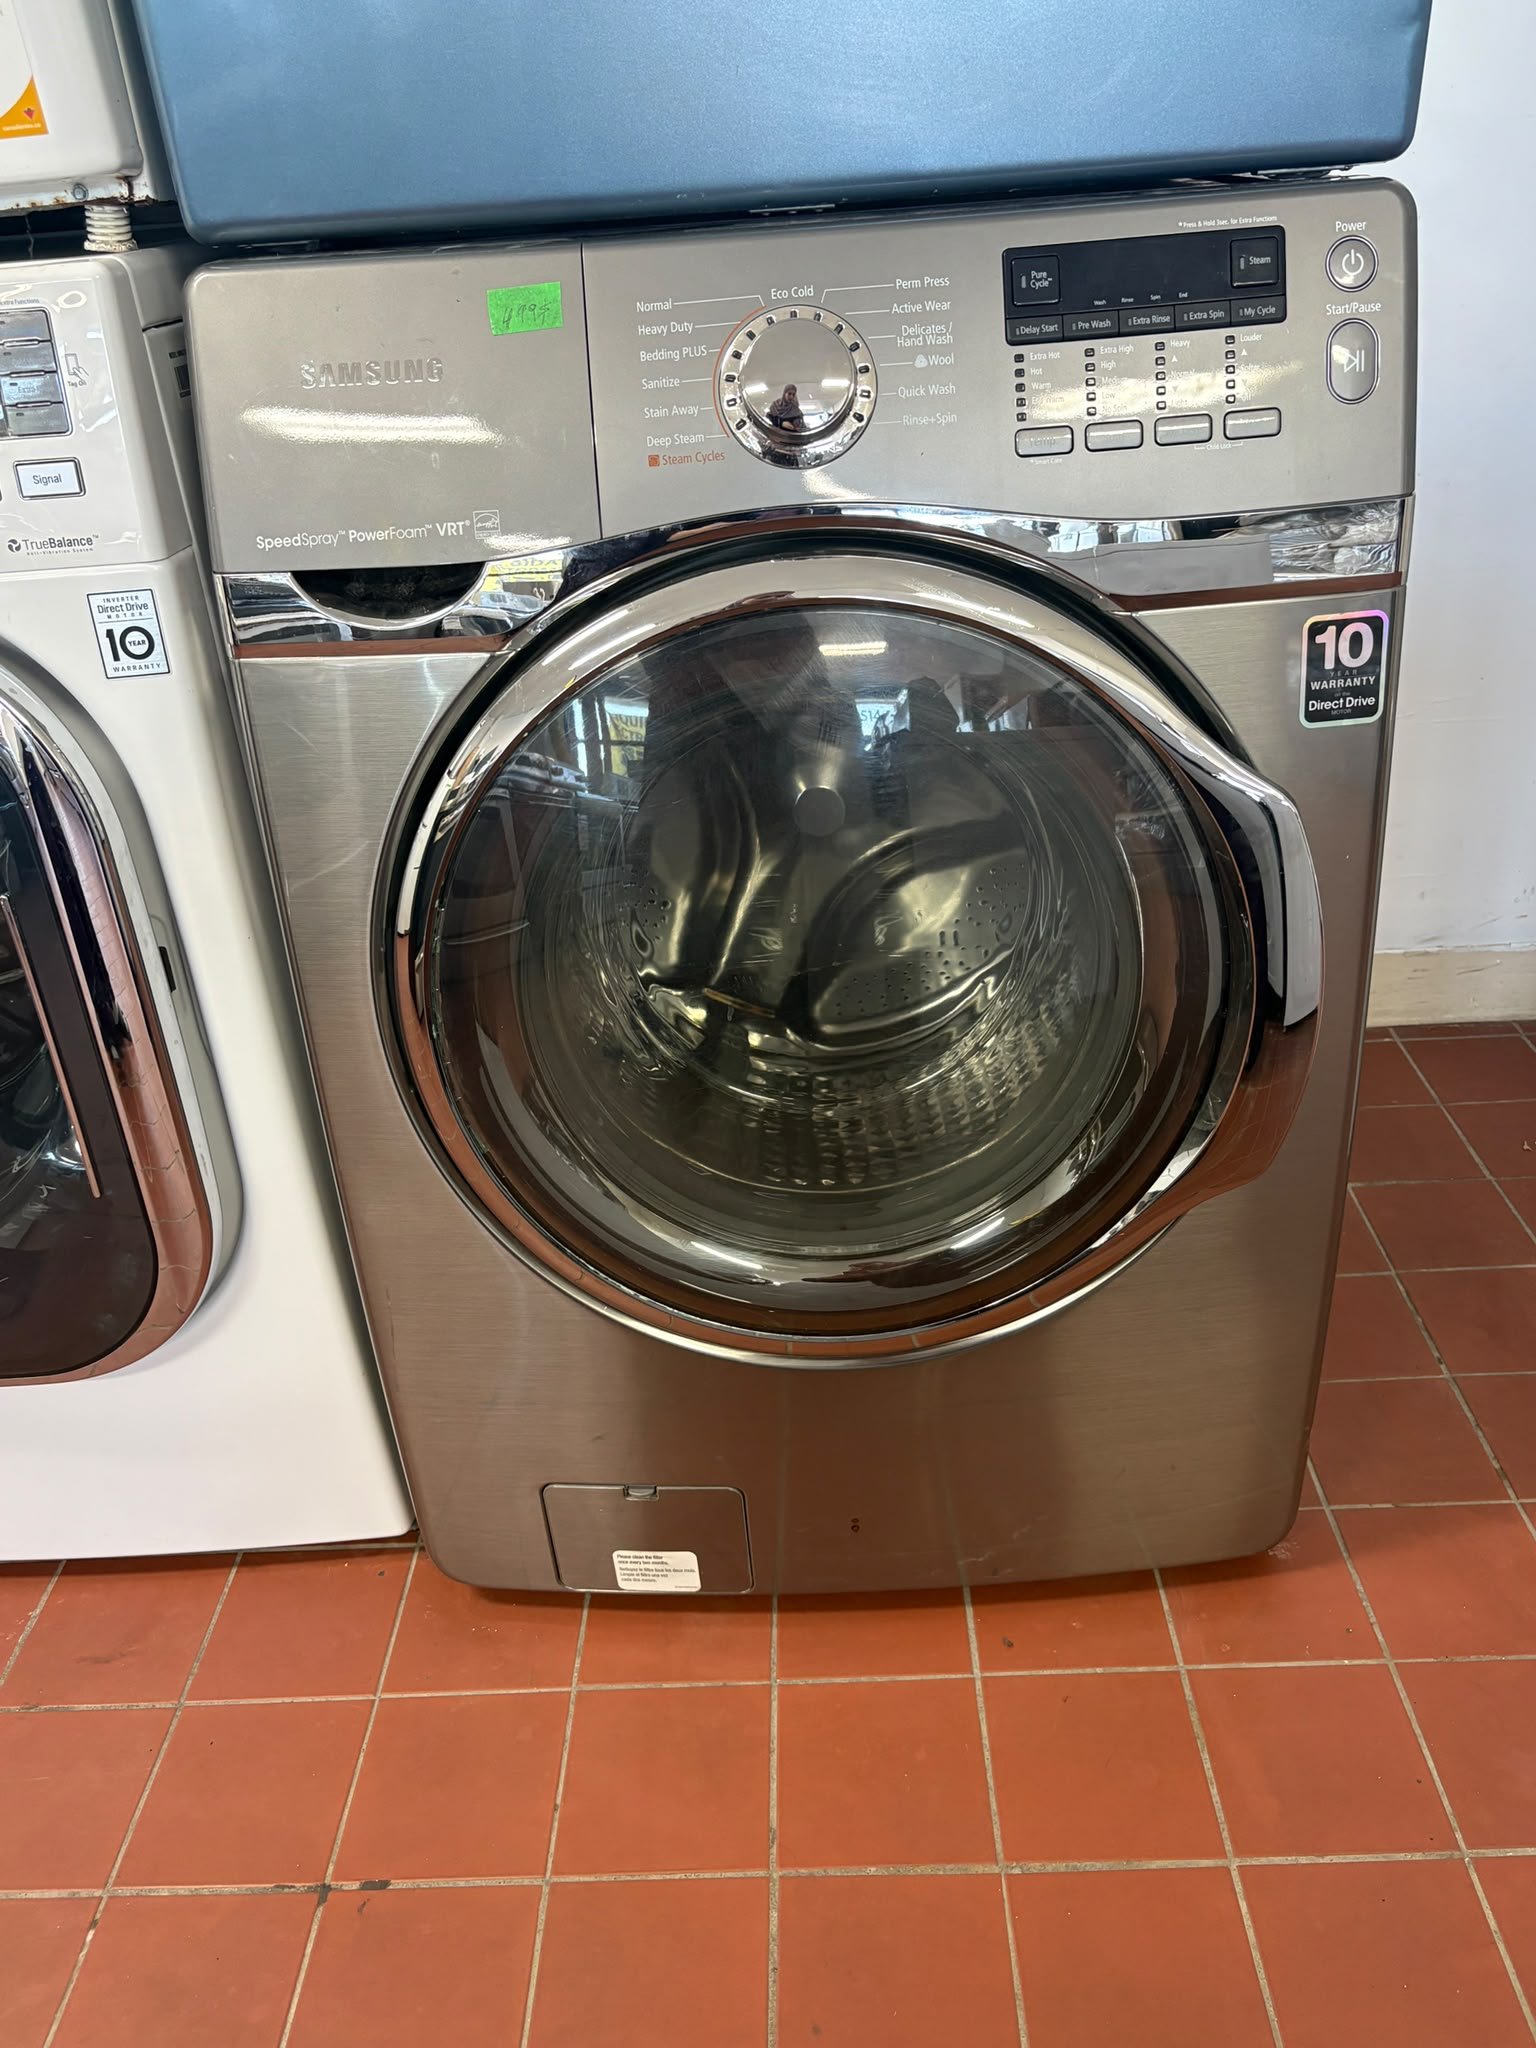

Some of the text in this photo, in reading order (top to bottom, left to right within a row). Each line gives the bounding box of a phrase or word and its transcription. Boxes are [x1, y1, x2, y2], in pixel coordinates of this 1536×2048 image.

[1239, 216, 1253, 224] Extra
[1335, 221, 1366, 232] Power
[1249, 256, 1271, 265] Steam
[1031, 271, 1048, 279] Pure
[896, 276, 950, 290] Perm Press
[771, 285, 814, 300] Eco Cold
[636, 298, 672, 312] Normal
[892, 301, 951, 315] Active Wear
[1244, 305, 1276, 318] My Cycle
[1326, 302, 1381, 315] Start/Pause
[1132, 314, 1171, 326] Extra Rinse
[1189, 309, 1225, 321] Extra Spin
[638, 321, 693, 336] Heavy Duty
[1020, 323, 1058, 335] Delay Start
[1078, 318, 1111, 330] Pre Wash
[897, 333, 953, 348] Hand Wash
[1171, 339, 1191, 349] Heavy
[1241, 333, 1262, 342] Louder
[640, 345, 707, 362] Bedding PLUS
[1030, 351, 1061, 361] Extra Hot
[1101, 344, 1134, 355] Extra High
[928, 352, 954, 366] Wool
[1101, 360, 1117, 370] High
[300, 358, 443, 389] SAMSUNG
[642, 376, 680, 390] Sanitize
[1031, 382, 1052, 390] Warm
[898, 382, 956, 399] Quick Wash
[644, 405, 699, 418] Stain Away
[903, 411, 958, 426] Rinse+Spin
[646, 434, 705, 448] Deep Steam
[662, 450, 726, 466] Steam Cycles
[32, 473, 62, 486] Signal
[103, 595, 139, 603] INVERTER
[97, 602, 149, 614] Direct Drive
[106, 626, 155, 662] 10
[128, 639, 147, 647] YEAR
[1315, 622, 1374, 670] 10
[113, 663, 161, 673] WARRANTY
[1330, 669, 1357, 677] YEAR
[1310, 676, 1376, 691] WARRANTY
[1308, 696, 1376, 711] Direct Drive
